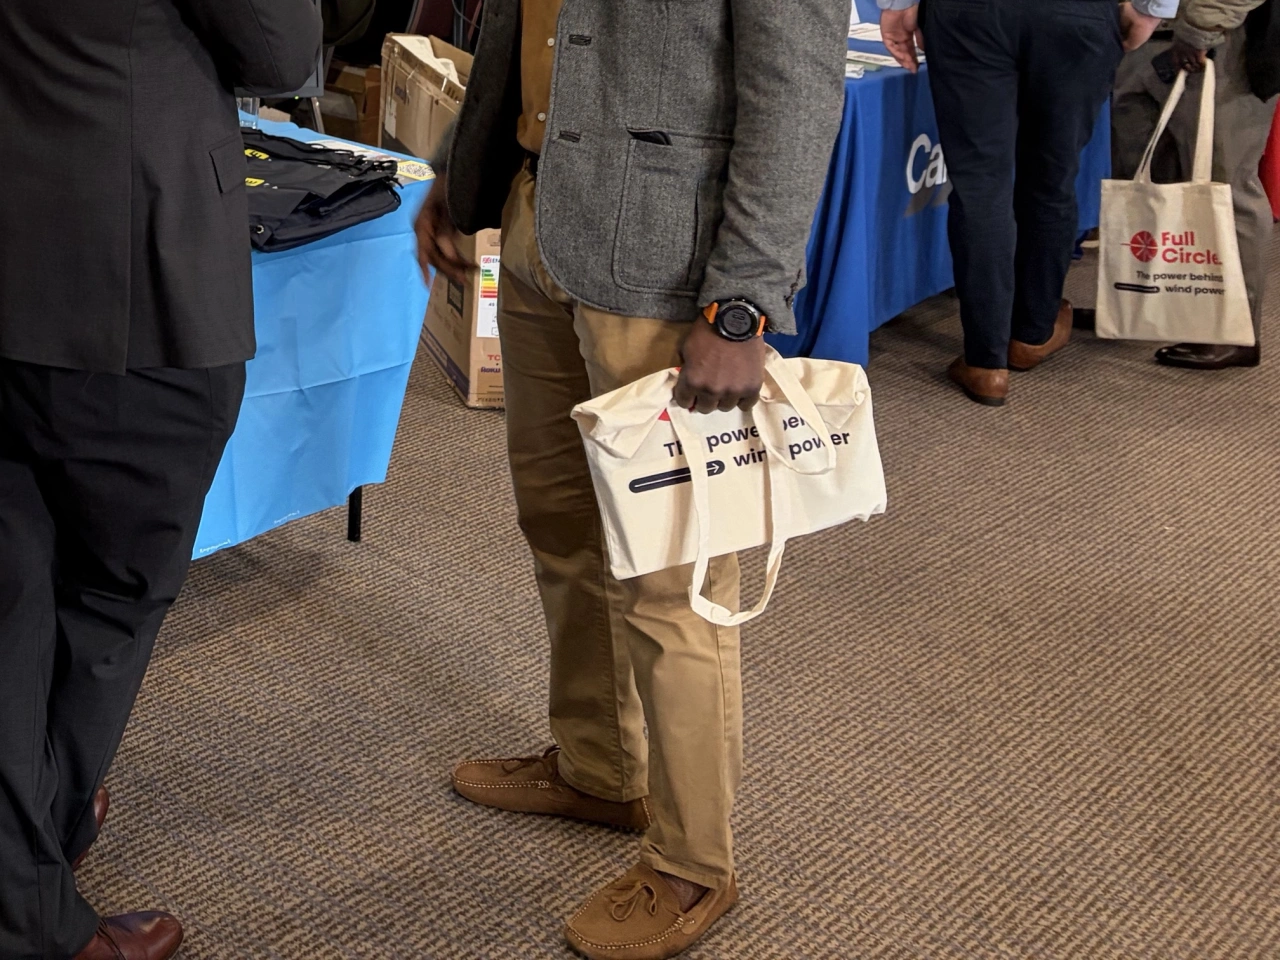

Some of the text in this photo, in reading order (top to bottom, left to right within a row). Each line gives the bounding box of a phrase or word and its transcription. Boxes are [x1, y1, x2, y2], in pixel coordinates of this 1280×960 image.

[906, 132, 948, 194] Ca
[1161, 231, 1195, 246] Full
[1136, 270, 1150, 280] The
[1153, 272, 1187, 282] power
[1165, 284, 1192, 294] wind
[663, 425, 760, 457] Th powe
[733, 432, 850, 467] win power
